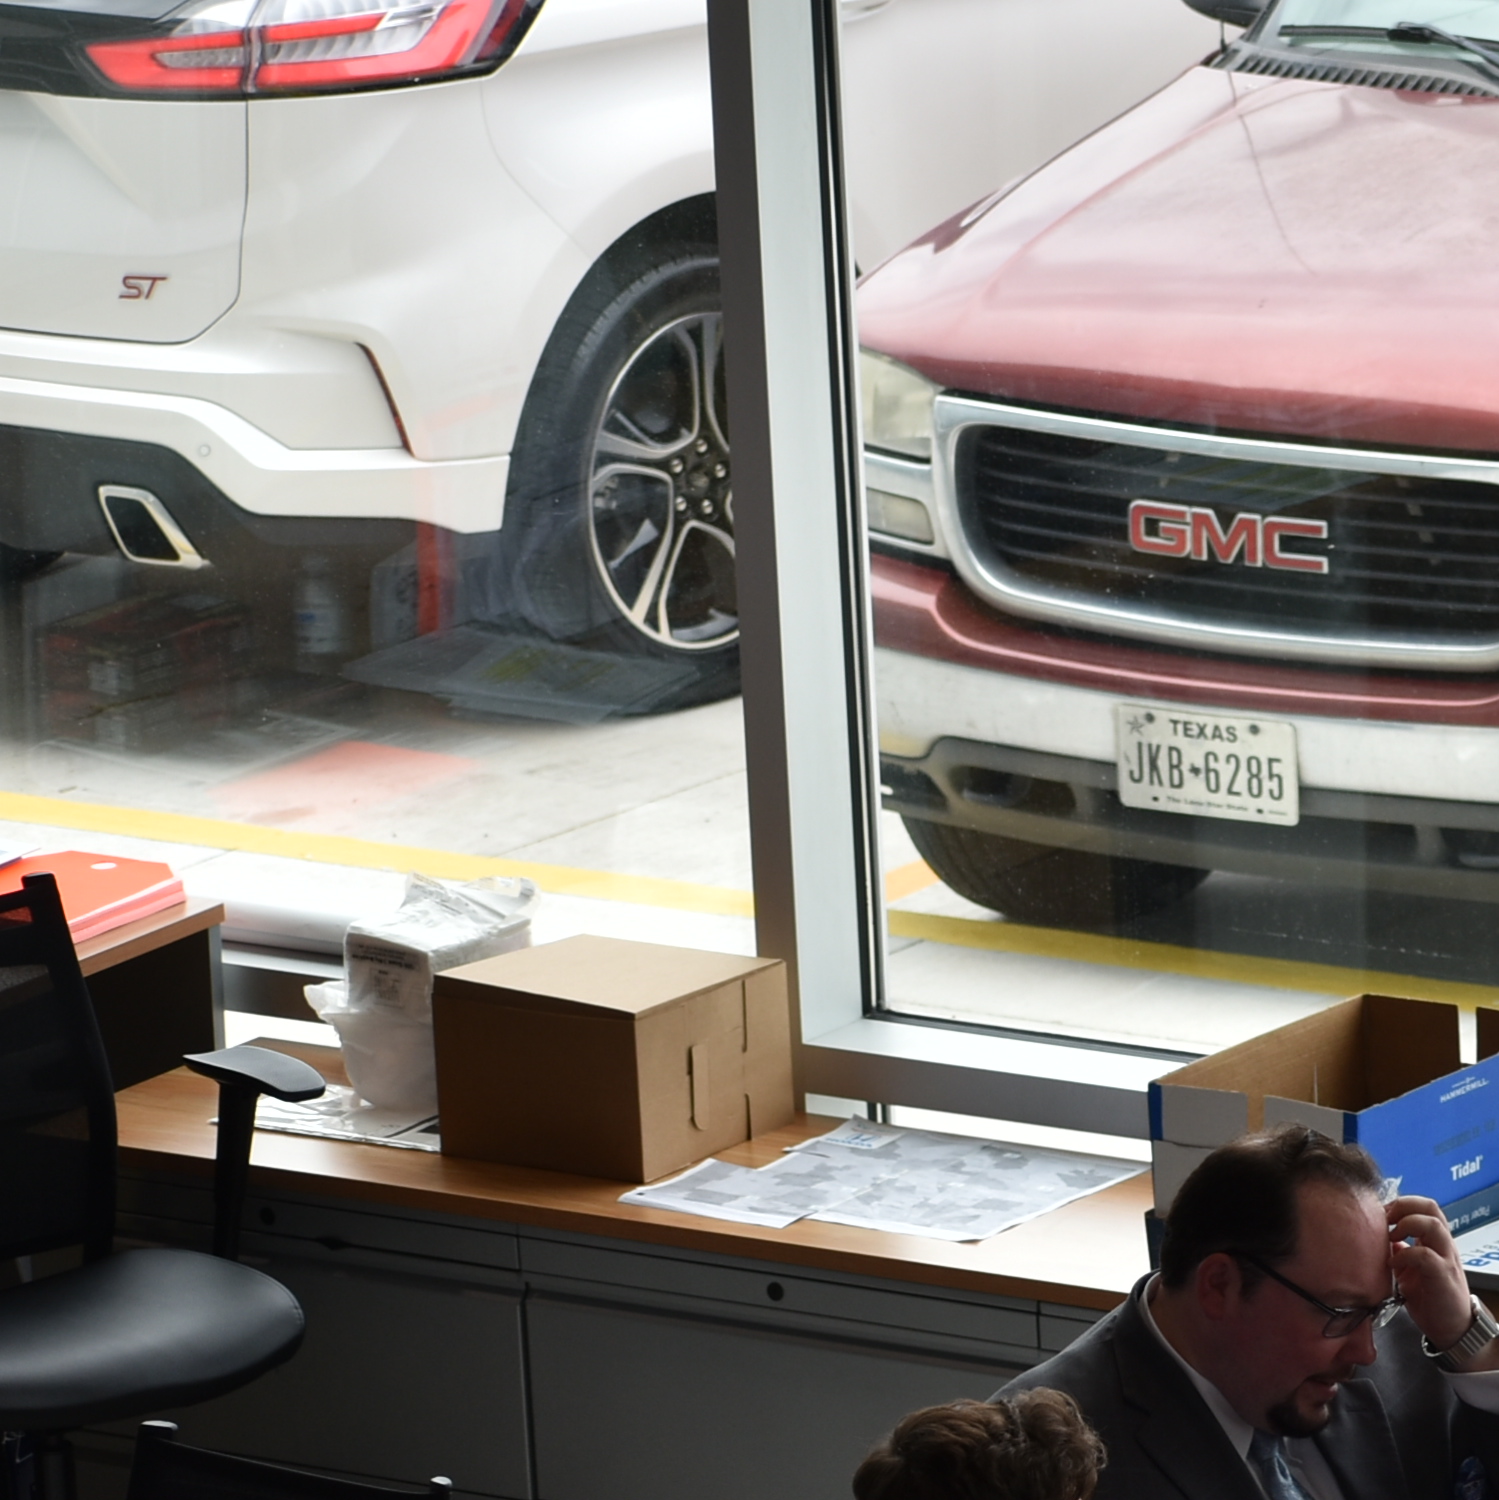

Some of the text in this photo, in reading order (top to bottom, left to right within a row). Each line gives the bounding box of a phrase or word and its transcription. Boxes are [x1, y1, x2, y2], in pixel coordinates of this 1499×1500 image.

[118, 274, 168, 300] ST
[1129, 499, 1329, 574] GMC
[1169, 718, 1239, 743] TEXAS
